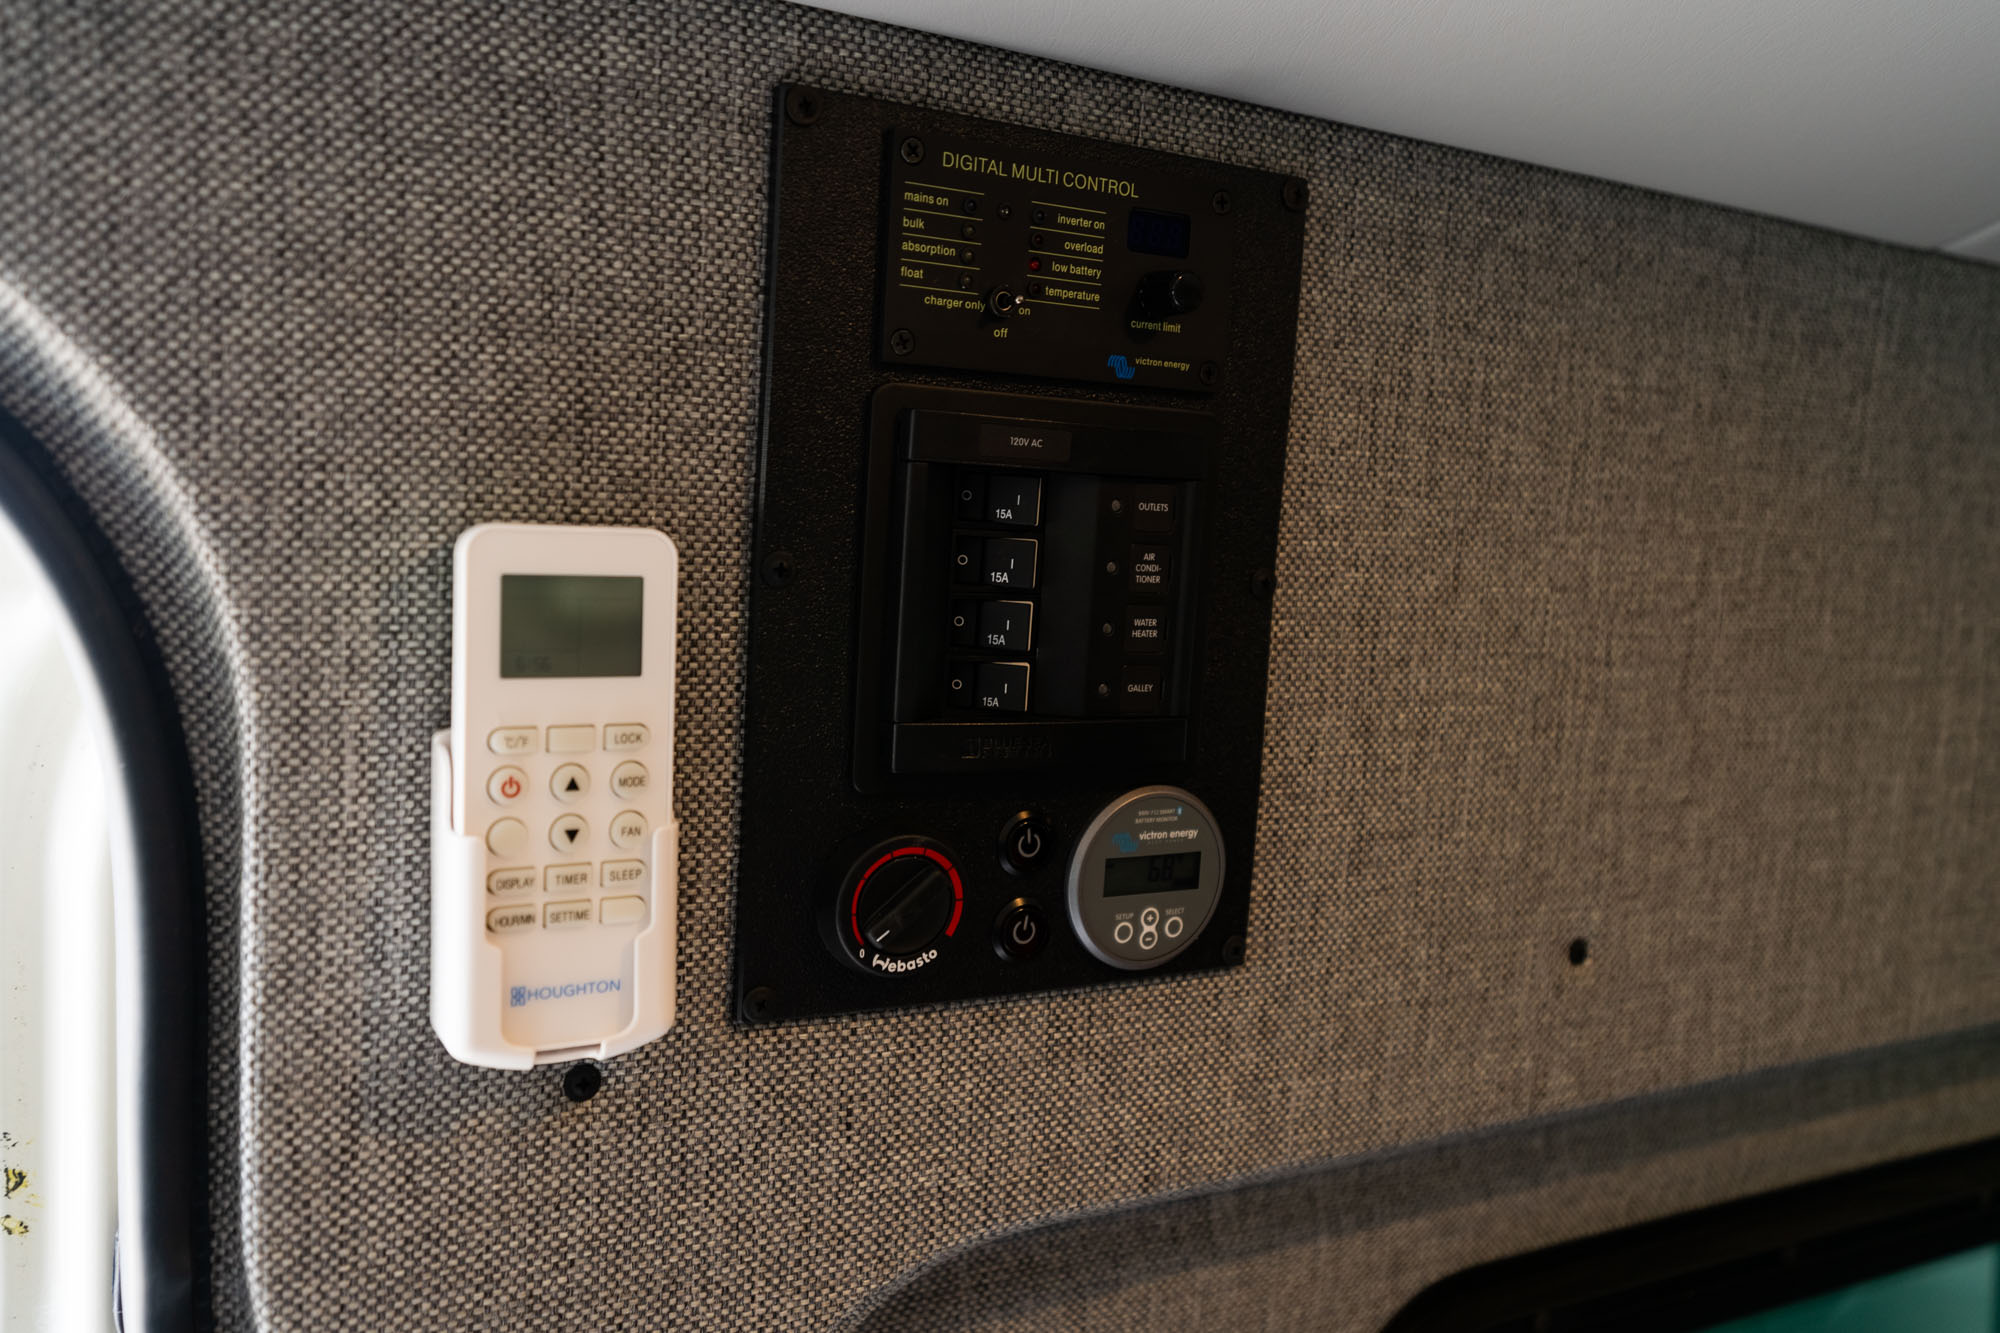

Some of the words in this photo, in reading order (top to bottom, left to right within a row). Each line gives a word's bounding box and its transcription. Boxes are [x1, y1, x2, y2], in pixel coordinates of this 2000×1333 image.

[942, 151, 1007, 177] DIGITAL
[1011, 162, 1059, 185] MULTI
[1063, 171, 1139, 198] CONTROL
[904, 191, 933, 205] mains
[935, 196, 949, 206] on
[902, 216, 925, 229] bulk
[1057, 214, 1090, 228] inverter
[1092, 219, 1105, 230] on
[902, 240, 956, 258] absorption
[1064, 240, 1104, 255] overload
[900, 266, 924, 279] float
[1052, 260, 1068, 273] low
[1070, 263, 1102, 279] battery
[1045, 285, 1100, 303] temperature
[924, 294, 962, 309] charger
[965, 298, 986, 312] only
[1018, 306, 1031, 316] on
[993, 326, 1008, 339] off
[1130, 319, 1161, 332] current
[1163, 321, 1181, 334] limit
[1135, 356, 1162, 368] victron
[1163, 359, 1190, 372] energy
[1010, 436, 1031, 448] 120V
[1032, 437, 1044, 448] AC
[1138, 501, 1169, 512] OUTLETS
[995, 508, 1013, 520] 15A
[1143, 552, 1156, 561] AIR
[1135, 563, 1162, 573] CONDI-
[990, 572, 1009, 584] 15A
[1136, 574, 1161, 584] TIONER
[1134, 618, 1157, 628] WATER
[987, 634, 1006, 646] 15A
[1132, 629, 1158, 639] HEATER
[1127, 683, 1153, 693] GALLEY
[982, 696, 999, 707] 15A
[614, 733, 643, 744] LOCK
[619, 776, 646, 788] MODE
[621, 826, 641, 836] FAN
[1139, 830, 1167, 840] victron
[1169, 829, 1198, 839] energy
[555, 874, 588, 886] TIMER
[609, 869, 642, 882] SLEEP
[496, 877, 535, 890] DISPLAY
[1115, 912, 1134, 921] SETUP
[1165, 907, 1185, 915] SELECT
[872, 949, 938, 972] Webasto
[527, 979, 622, 1002] HOUGHTON
